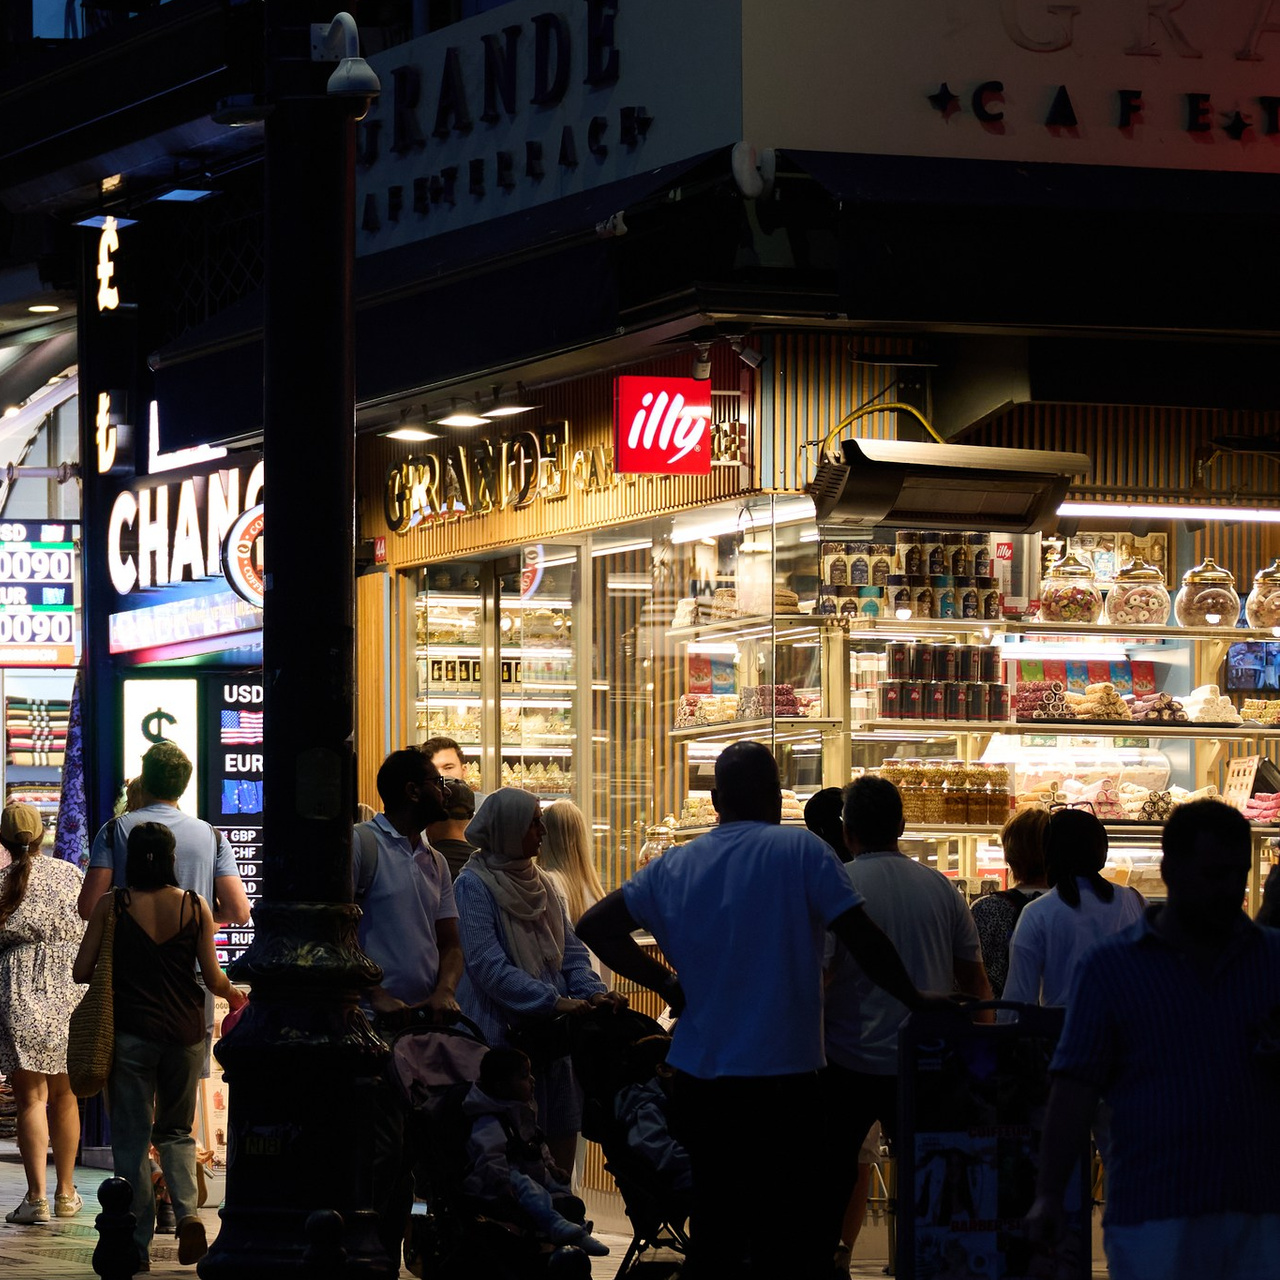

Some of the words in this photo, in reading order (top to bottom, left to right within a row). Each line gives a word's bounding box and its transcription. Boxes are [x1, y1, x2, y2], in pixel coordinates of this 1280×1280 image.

[973, 81, 1212, 132] CAFE
[627, 391, 706, 464] illy
[384, 420, 569, 532] GRANDE
[997, 545, 1012, 559] illy
[224, 685, 263, 703] USD
[225, 754, 263, 772] EUR
[231, 830, 256, 842] GBP
[233, 847, 256, 859] CHF
[239, 865, 256, 876] UD
[242, 882, 256, 893] AD
[951, 1220, 1021, 1233] BARBER'S
